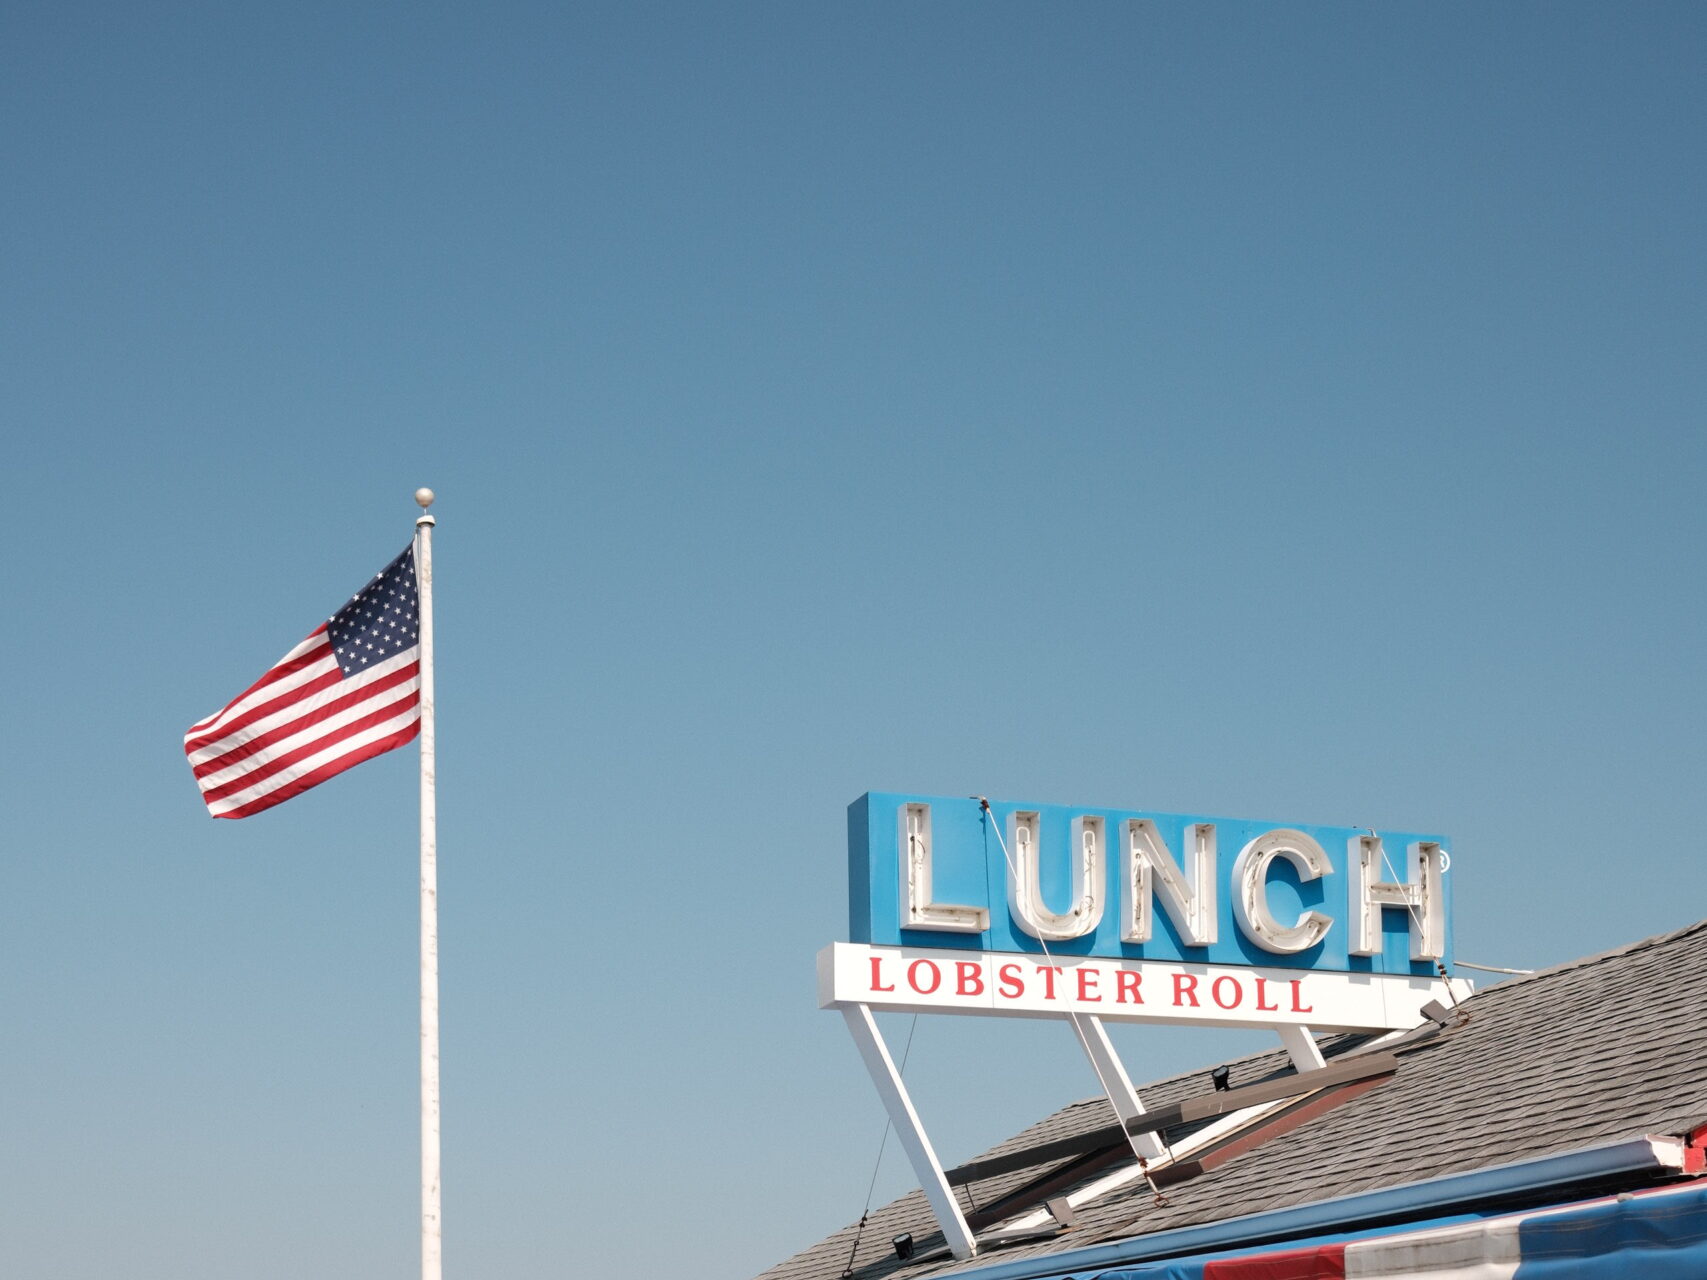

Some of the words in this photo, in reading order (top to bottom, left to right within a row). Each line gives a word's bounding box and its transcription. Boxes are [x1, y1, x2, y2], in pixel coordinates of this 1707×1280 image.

[899, 803, 1440, 962] LUNCH
[869, 956, 1145, 1005] LOBSTER
[1172, 974, 1313, 1013] ROLL
